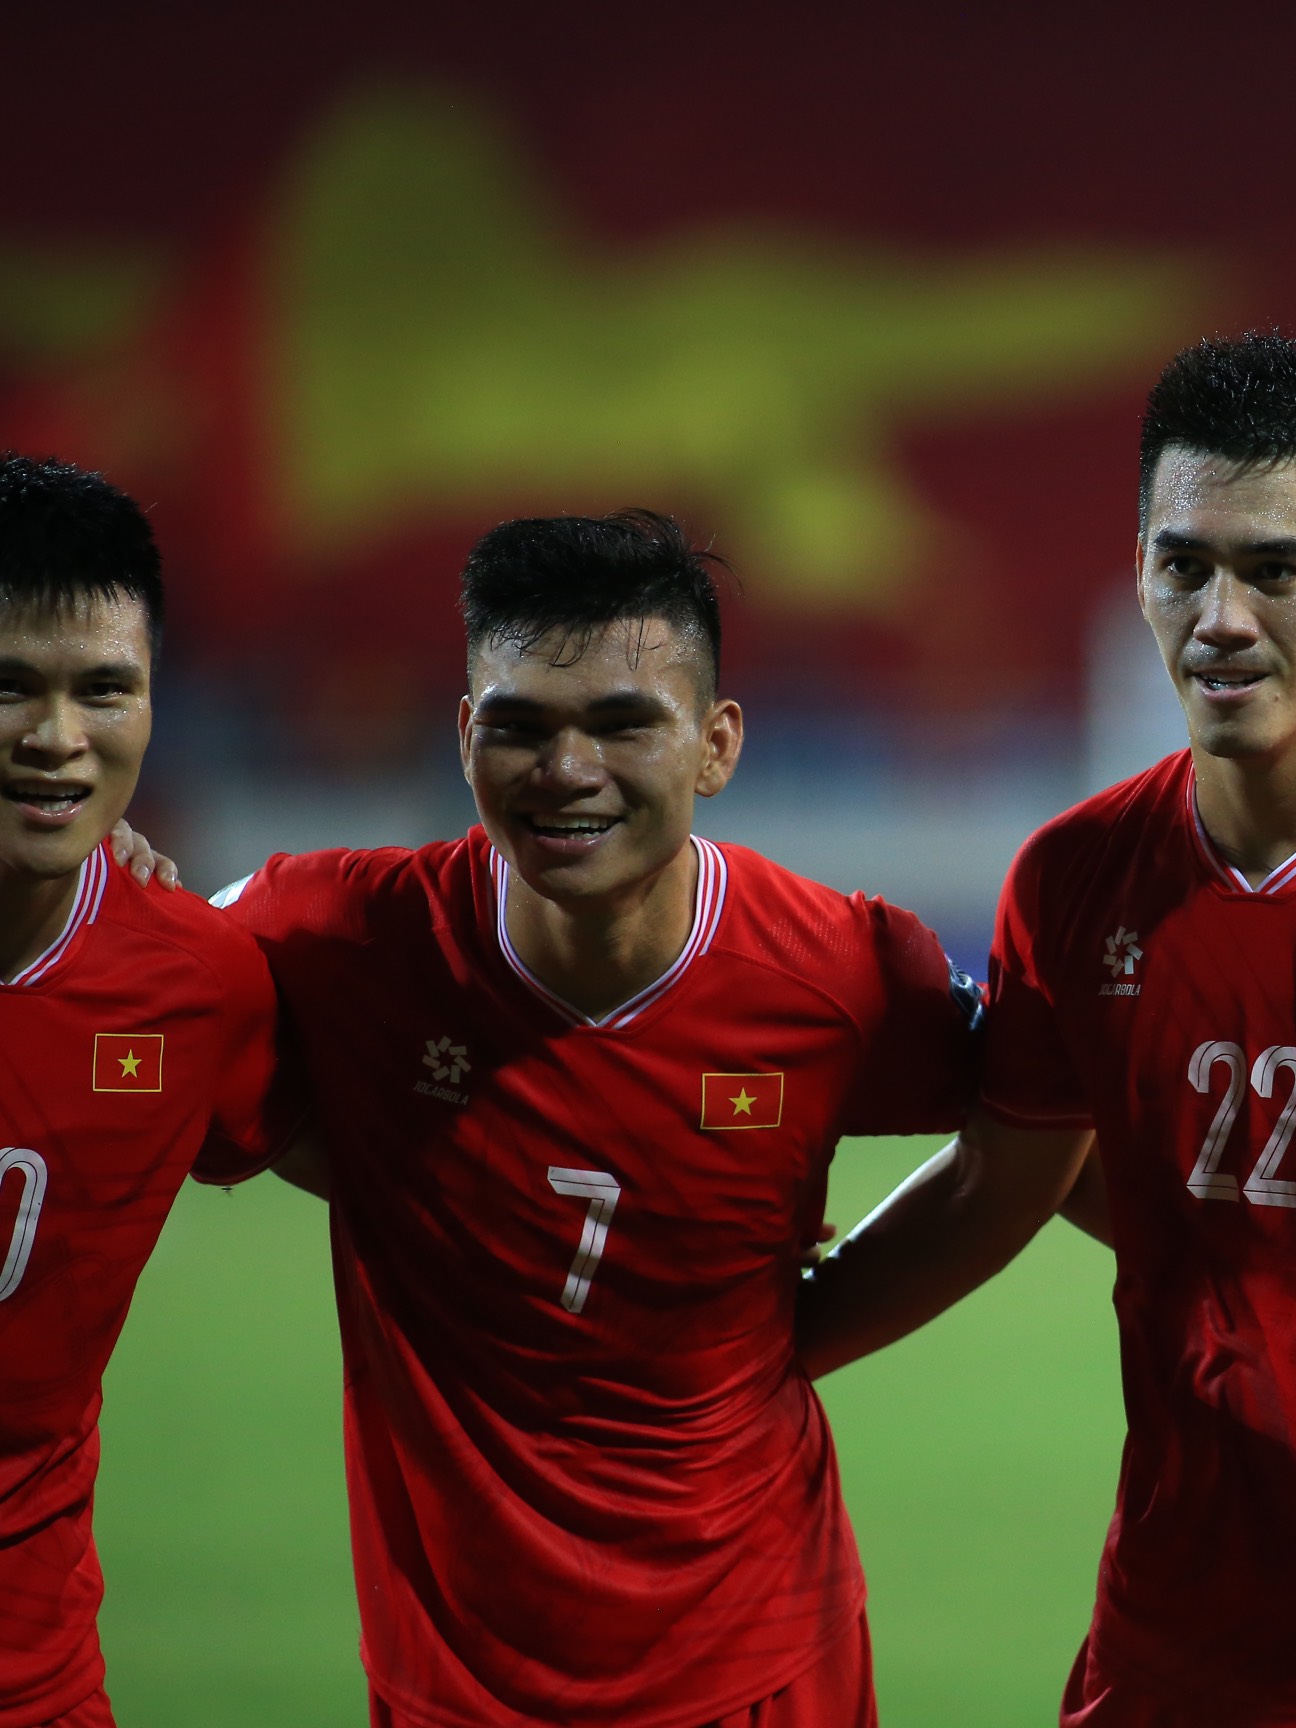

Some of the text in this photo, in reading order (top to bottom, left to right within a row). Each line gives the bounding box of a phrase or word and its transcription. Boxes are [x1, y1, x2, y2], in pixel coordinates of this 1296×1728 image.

[1098, 983, 1142, 996] JOGARBOLA
[412, 1080, 469, 1106] JOGARBOLA
[547, 1166, 621, 1314] 7
